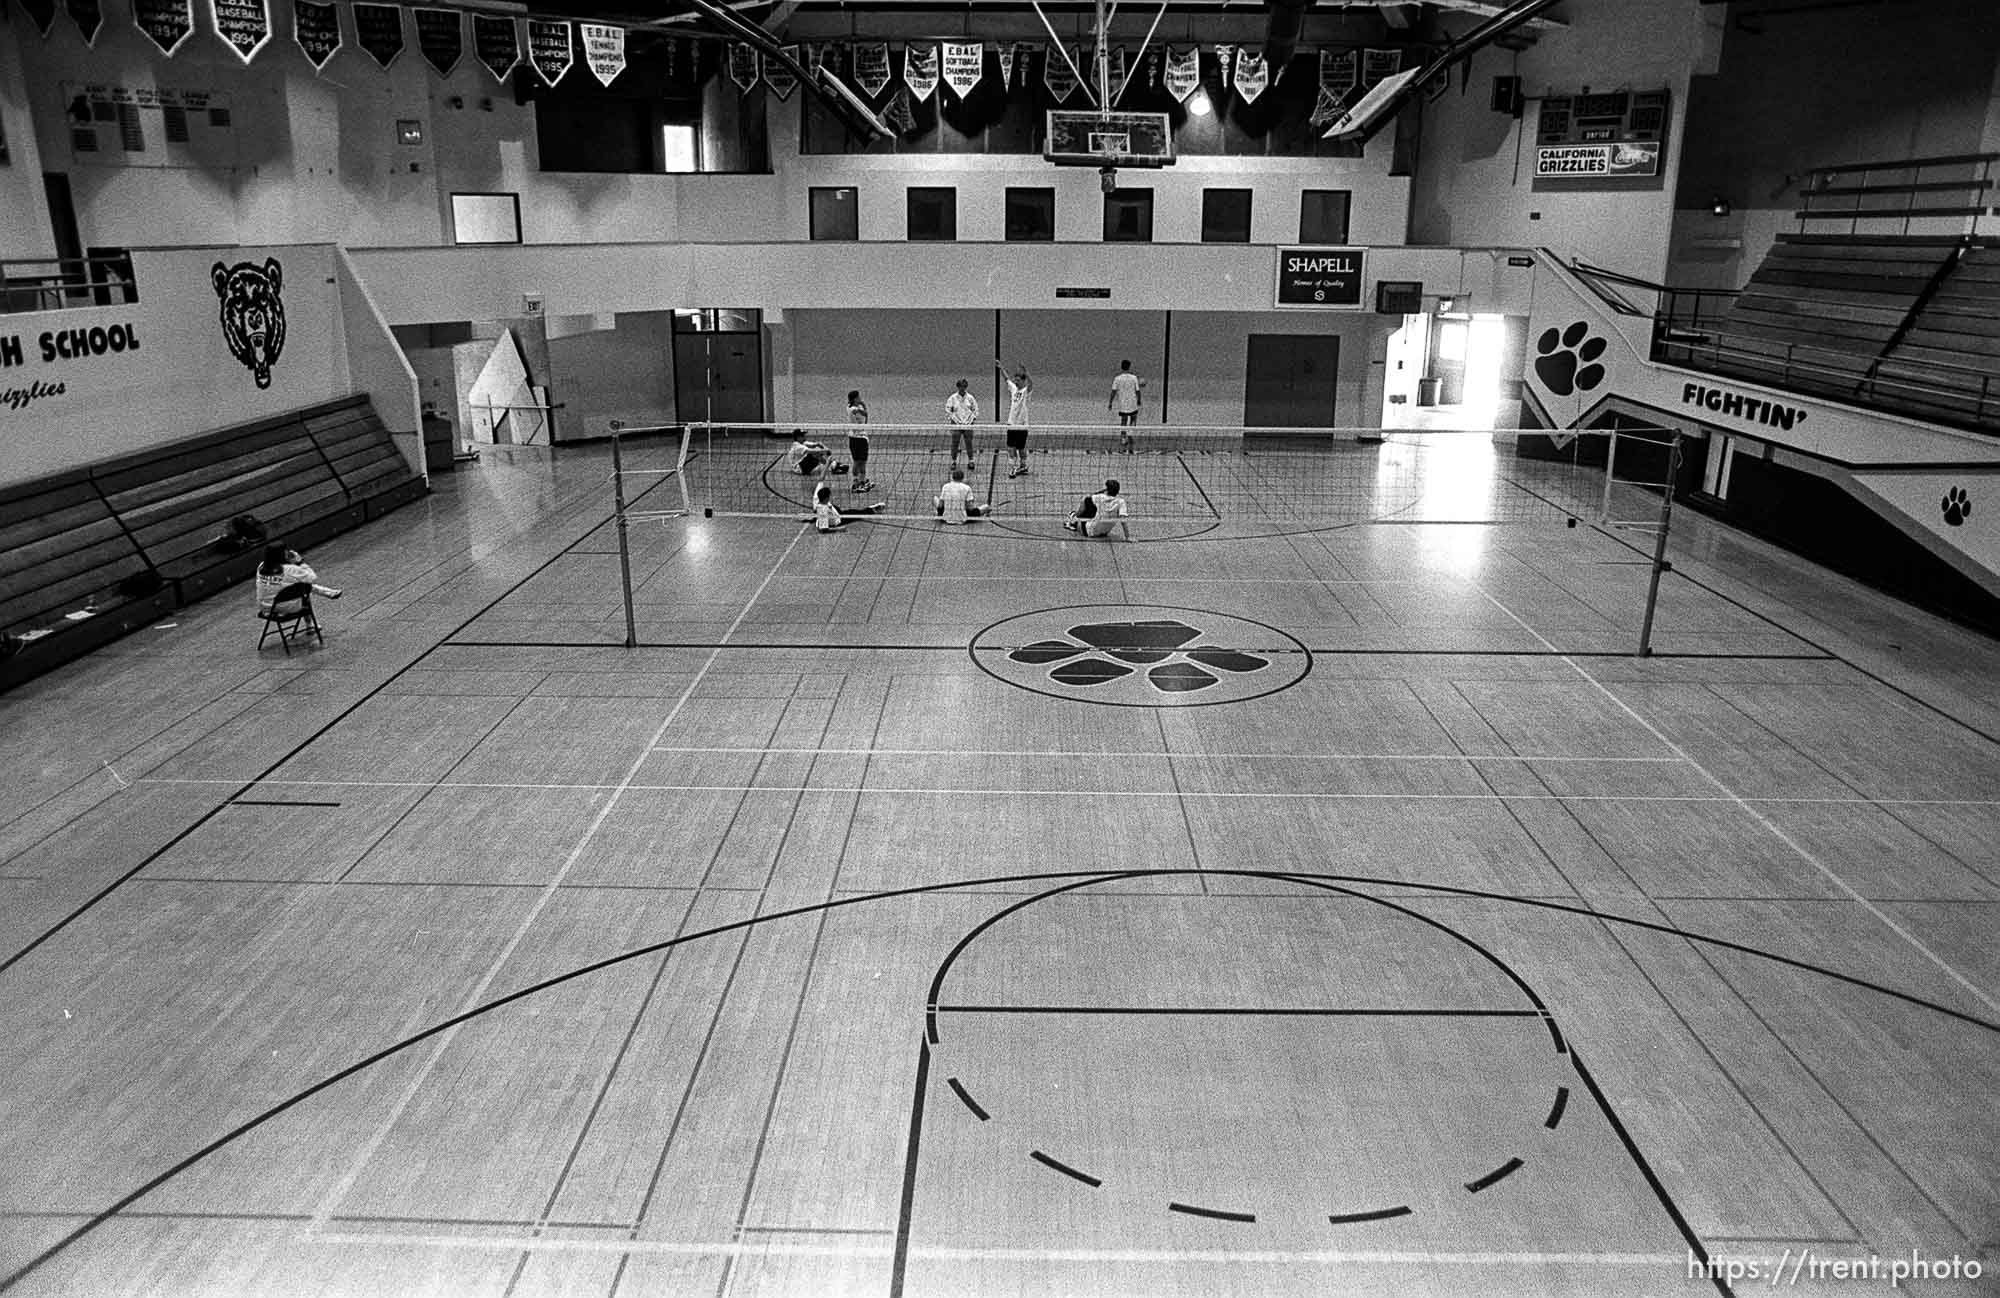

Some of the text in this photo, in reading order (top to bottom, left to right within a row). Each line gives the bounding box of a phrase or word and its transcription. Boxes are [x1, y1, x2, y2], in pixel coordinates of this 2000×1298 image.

[217, 6, 265, 21] BASEBALL
[231, 32, 256, 45] 1994
[591, 40, 616, 51] TENNIS
[539, 60, 563, 73] 1995
[945, 57, 979, 66] SOFTBALL
[595, 63, 617, 75] 1995
[945, 67, 980, 76] CHAMPIONS
[913, 79, 933, 89] 1986
[953, 76, 973, 86] 1986
[1540, 148, 1606, 159] CALIFORNIA
[1539, 159, 1605, 173] GRIZZLIES
[1288, 257, 1354, 273] SHAPELL
[1323, 279, 1345, 288] Quality
[38, 323, 140, 362] SCHOOL
[1682, 382, 1808, 431] FIGHTIN'
